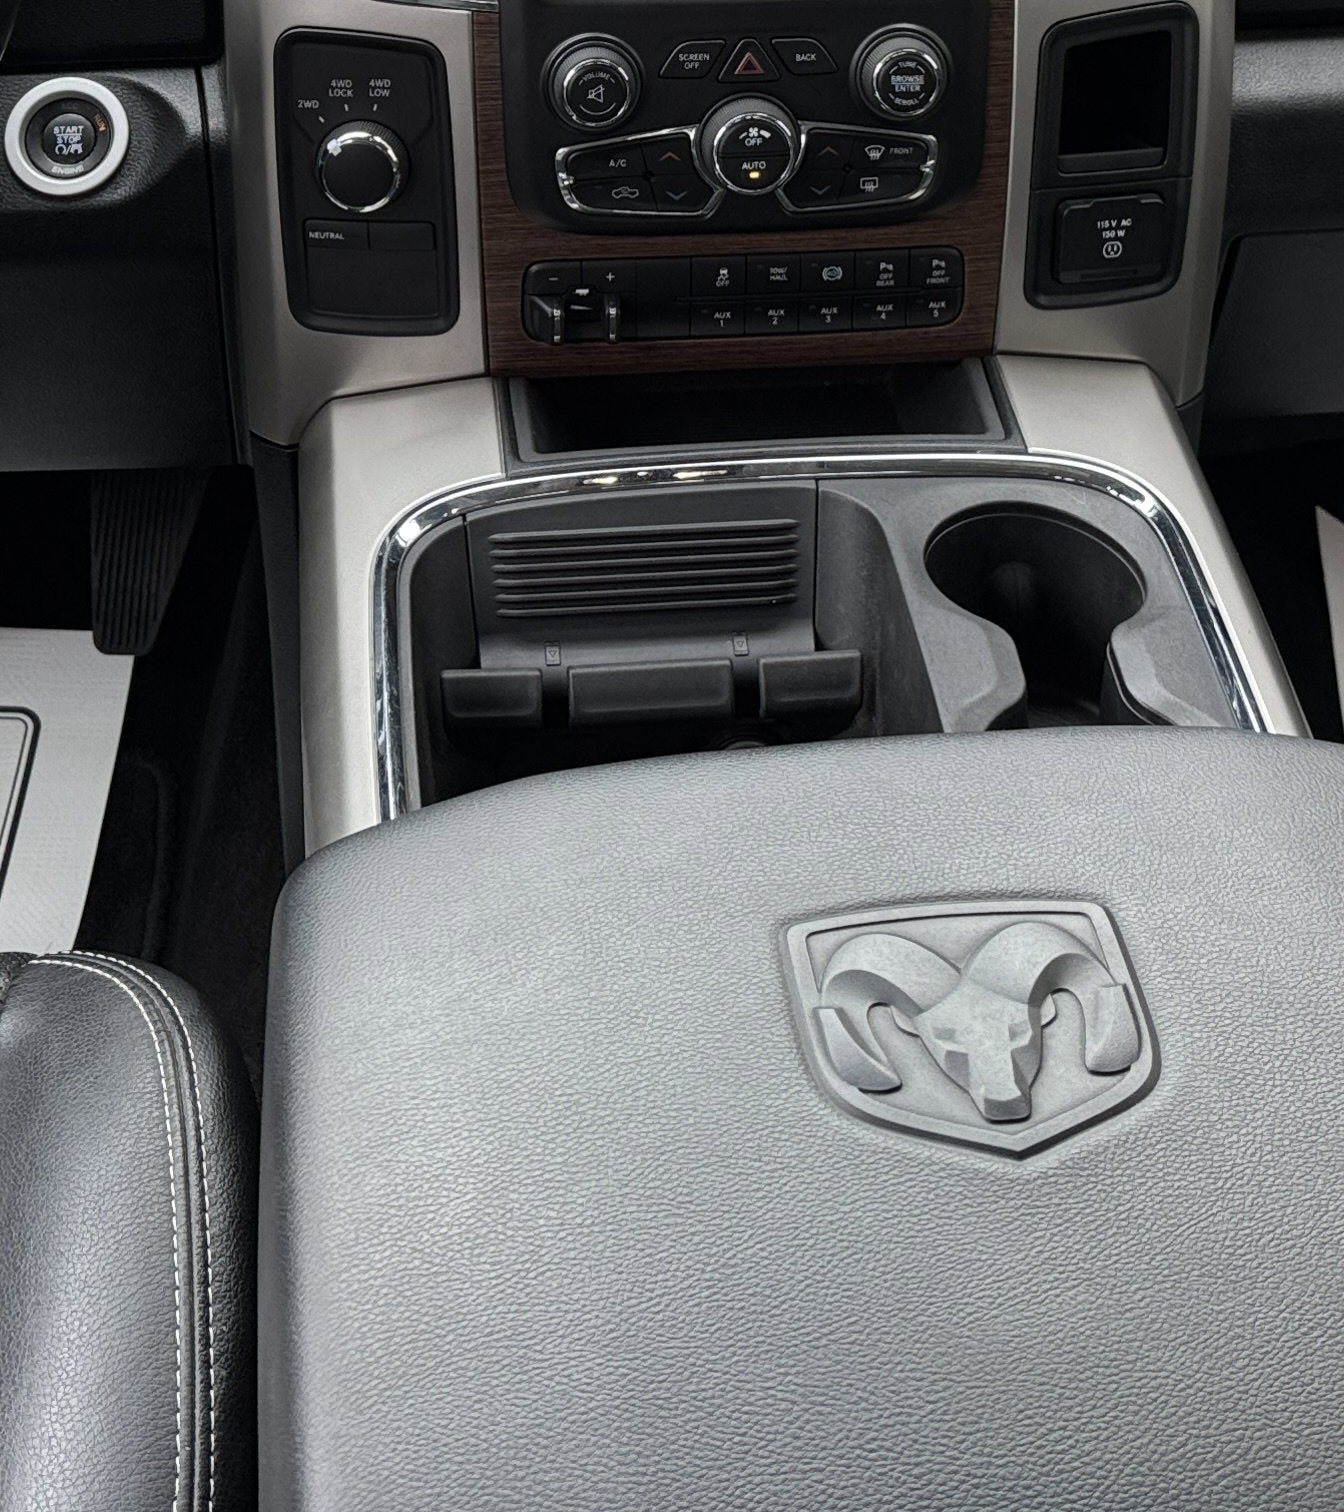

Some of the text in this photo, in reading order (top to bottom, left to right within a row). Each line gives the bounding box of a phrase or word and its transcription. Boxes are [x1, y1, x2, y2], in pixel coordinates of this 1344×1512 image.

[678, 53, 710, 61] SCREEN
[795, 53, 817, 62] BACK
[684, 62, 699, 70] OFF
[582, 72, 611, 82] VOLUME
[891, 75, 925, 84] BROWSE
[330, 79, 352, 88] 4WD
[369, 79, 391, 88] 4WD
[895, 84, 921, 92] ENTER
[329, 89, 353, 97] LOCK
[369, 89, 390, 97] LOW
[298, 99, 319, 109] 2WD
[53, 126, 84, 134] START
[56, 136, 82, 144] STOP
[744, 138, 763, 147] OFF
[889, 147, 914, 155] FRONT
[608, 159, 627, 168] A/C
[741, 160, 766, 170] AUTO
[1111, 219, 1117, 228] V
[1120, 218, 1132, 227] AC
[308, 231, 345, 240] NEUTRAL
[1117, 229, 1126, 238] W
[879, 272, 893, 280] OFF
[932, 269, 946, 277] OFF
[715, 279, 730, 287] OFF
[876, 279, 895, 287] REAR
[926, 276, 950, 285] FRONT
[876, 304, 893, 312] AUX
[929, 301, 946, 309] AUX
[714, 311, 731, 319] AUX
[768, 309, 785, 317] AUX
[879, 312, 886, 320] 4
[933, 309, 939, 317] 5
[772, 317, 778, 325] 2
[825, 315, 831, 323] 3
[719, 320, 724, 328] 1
